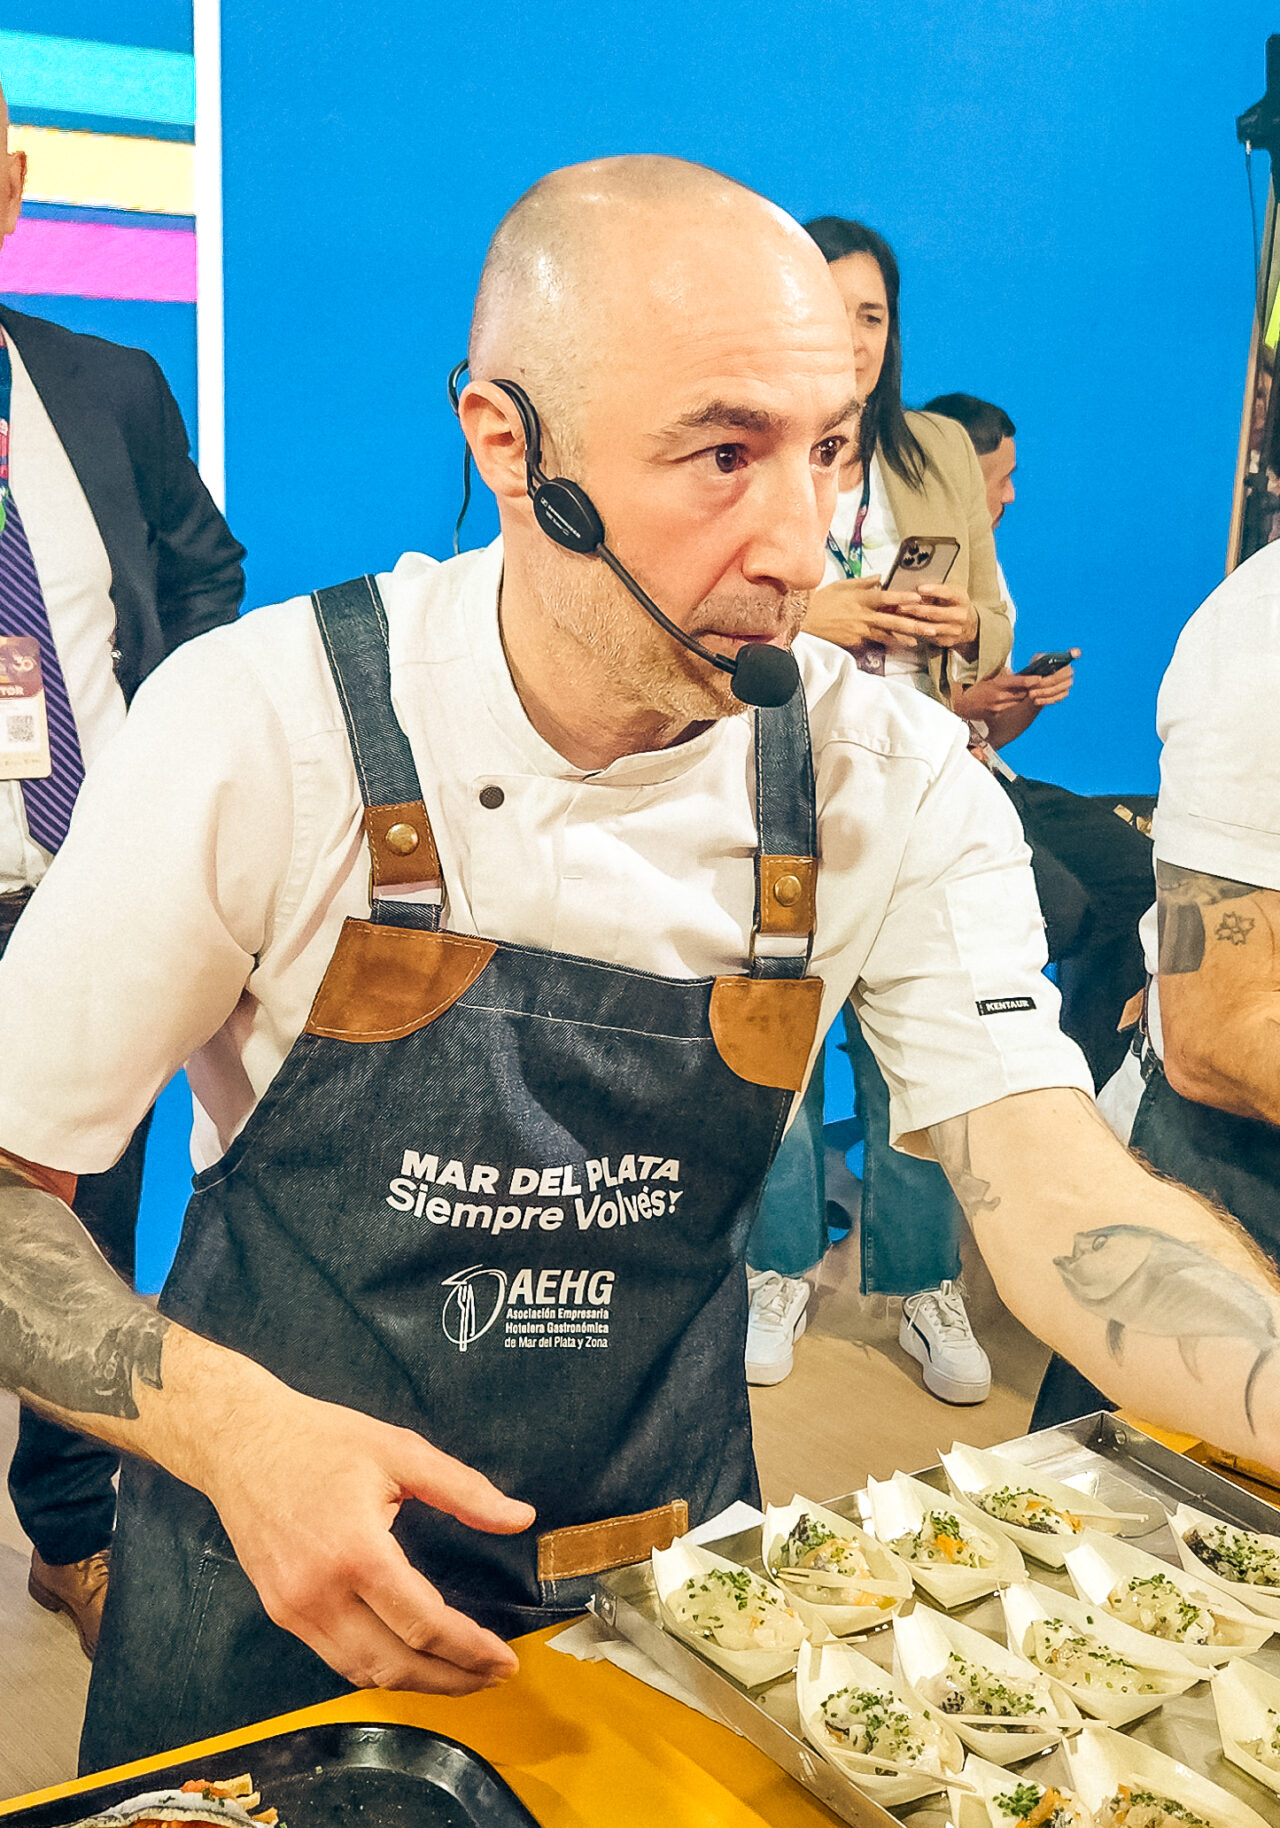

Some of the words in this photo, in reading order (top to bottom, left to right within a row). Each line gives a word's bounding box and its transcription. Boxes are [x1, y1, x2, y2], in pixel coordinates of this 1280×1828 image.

[986, 1000, 1029, 1011] KENTAUR
[400, 1149, 500, 1195] MAR
[509, 1164, 582, 1197] DEL
[585, 1154, 681, 1192] PLATA
[386, 1178, 564, 1235] Siempre
[507, 1268, 615, 1305] AEHG
[506, 1307, 556, 1320] Asociación
[558, 1308, 609, 1321] Empresaria
[505, 1322, 545, 1334] Hotelera
[547, 1321, 609, 1334] Gastronómica
[504, 1337, 516, 1348] de
[519, 1336, 537, 1348] Mar
[538, 1337, 552, 1348] del
[554, 1336, 576, 1348] Plata
[577, 1338, 584, 1350] y
[585, 1336, 609, 1348] Zona
